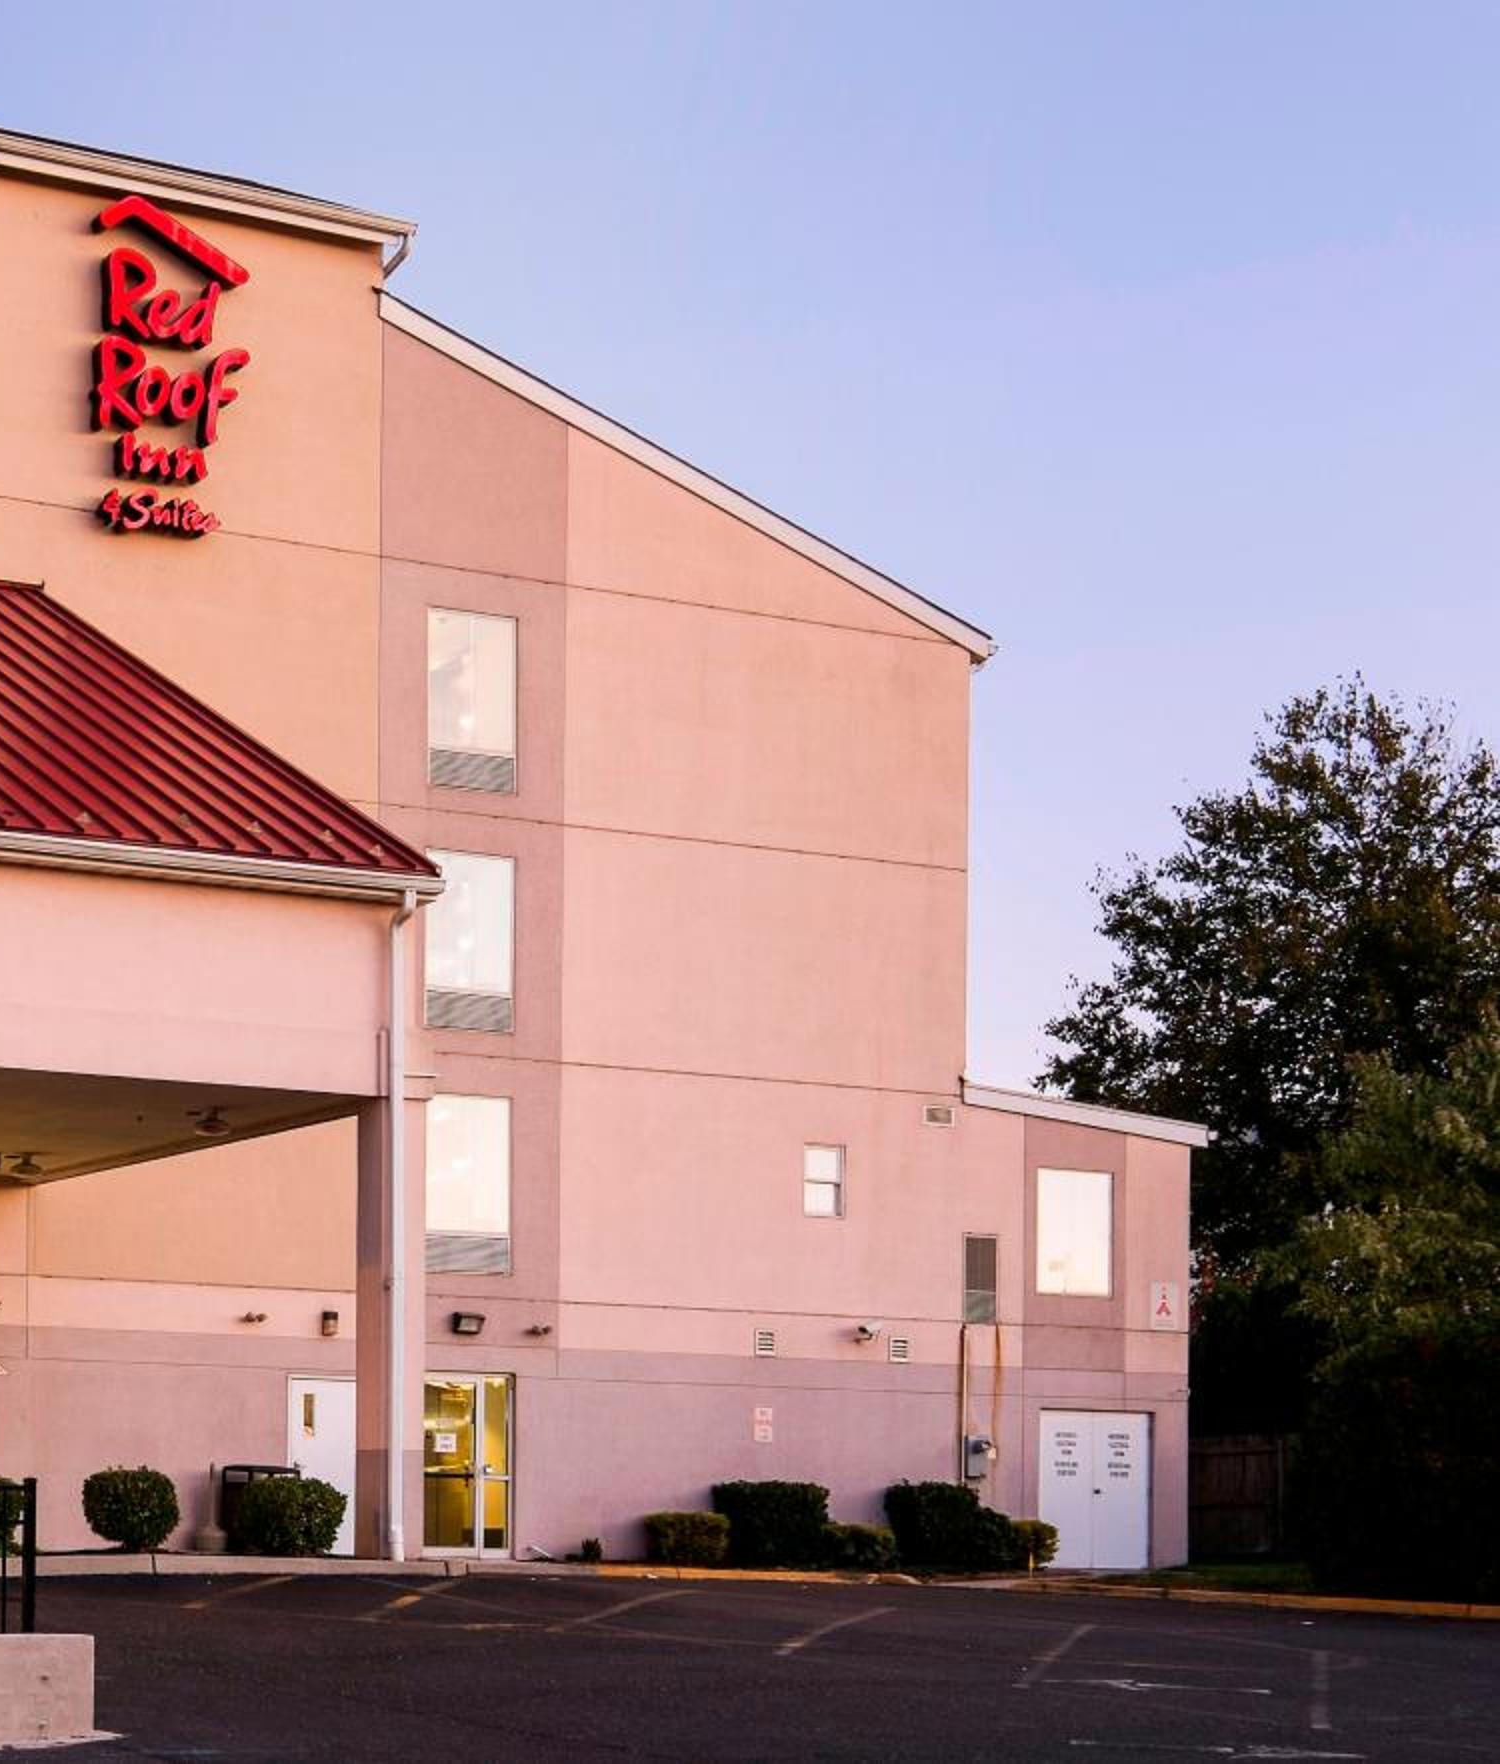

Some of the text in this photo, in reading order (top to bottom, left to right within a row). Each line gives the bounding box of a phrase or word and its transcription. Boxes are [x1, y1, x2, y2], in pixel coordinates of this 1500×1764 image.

[103, 247, 221, 348] Red
[92, 335, 250, 447] Roof
[114, 431, 209, 483] Inn
